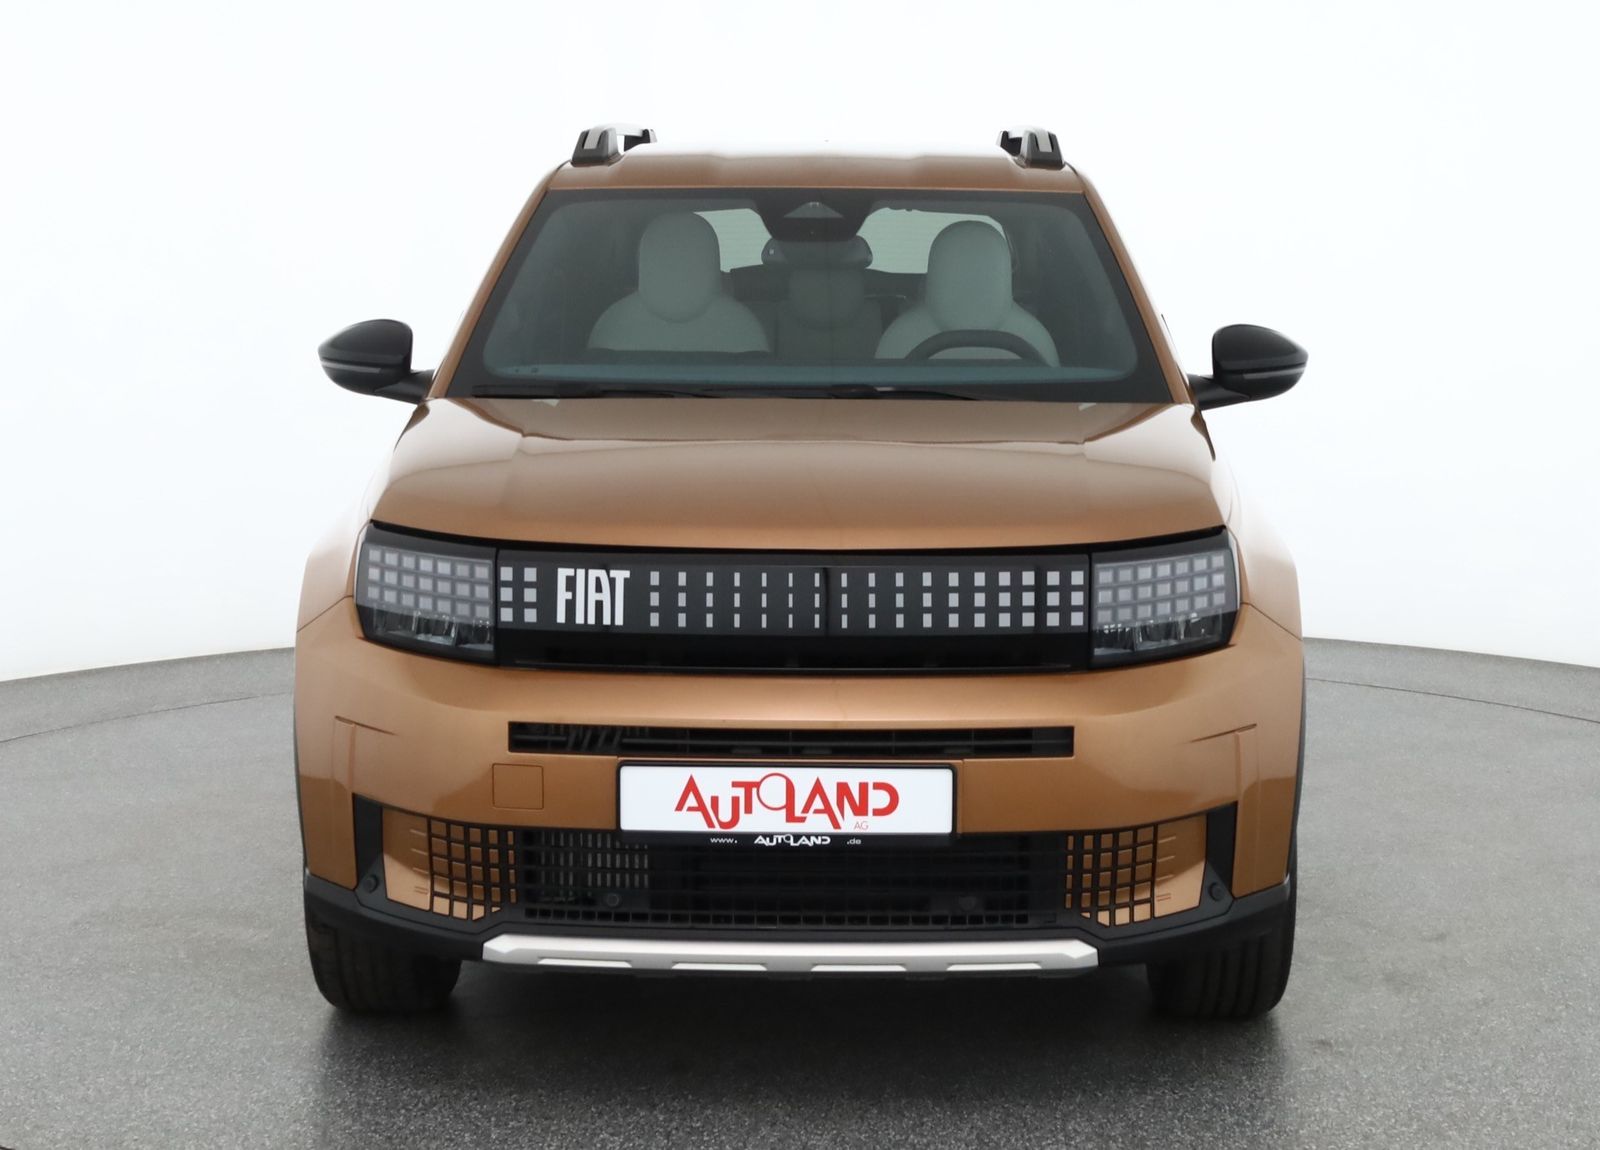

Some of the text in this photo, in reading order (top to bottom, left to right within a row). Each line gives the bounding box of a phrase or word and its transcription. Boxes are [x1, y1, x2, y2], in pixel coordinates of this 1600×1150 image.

[556, 567, 630, 626] FIAT
[675, 772, 899, 830] AUTOLAND
[754, 834, 831, 846] AUTOLAND
[853, 820, 869, 831] AG
